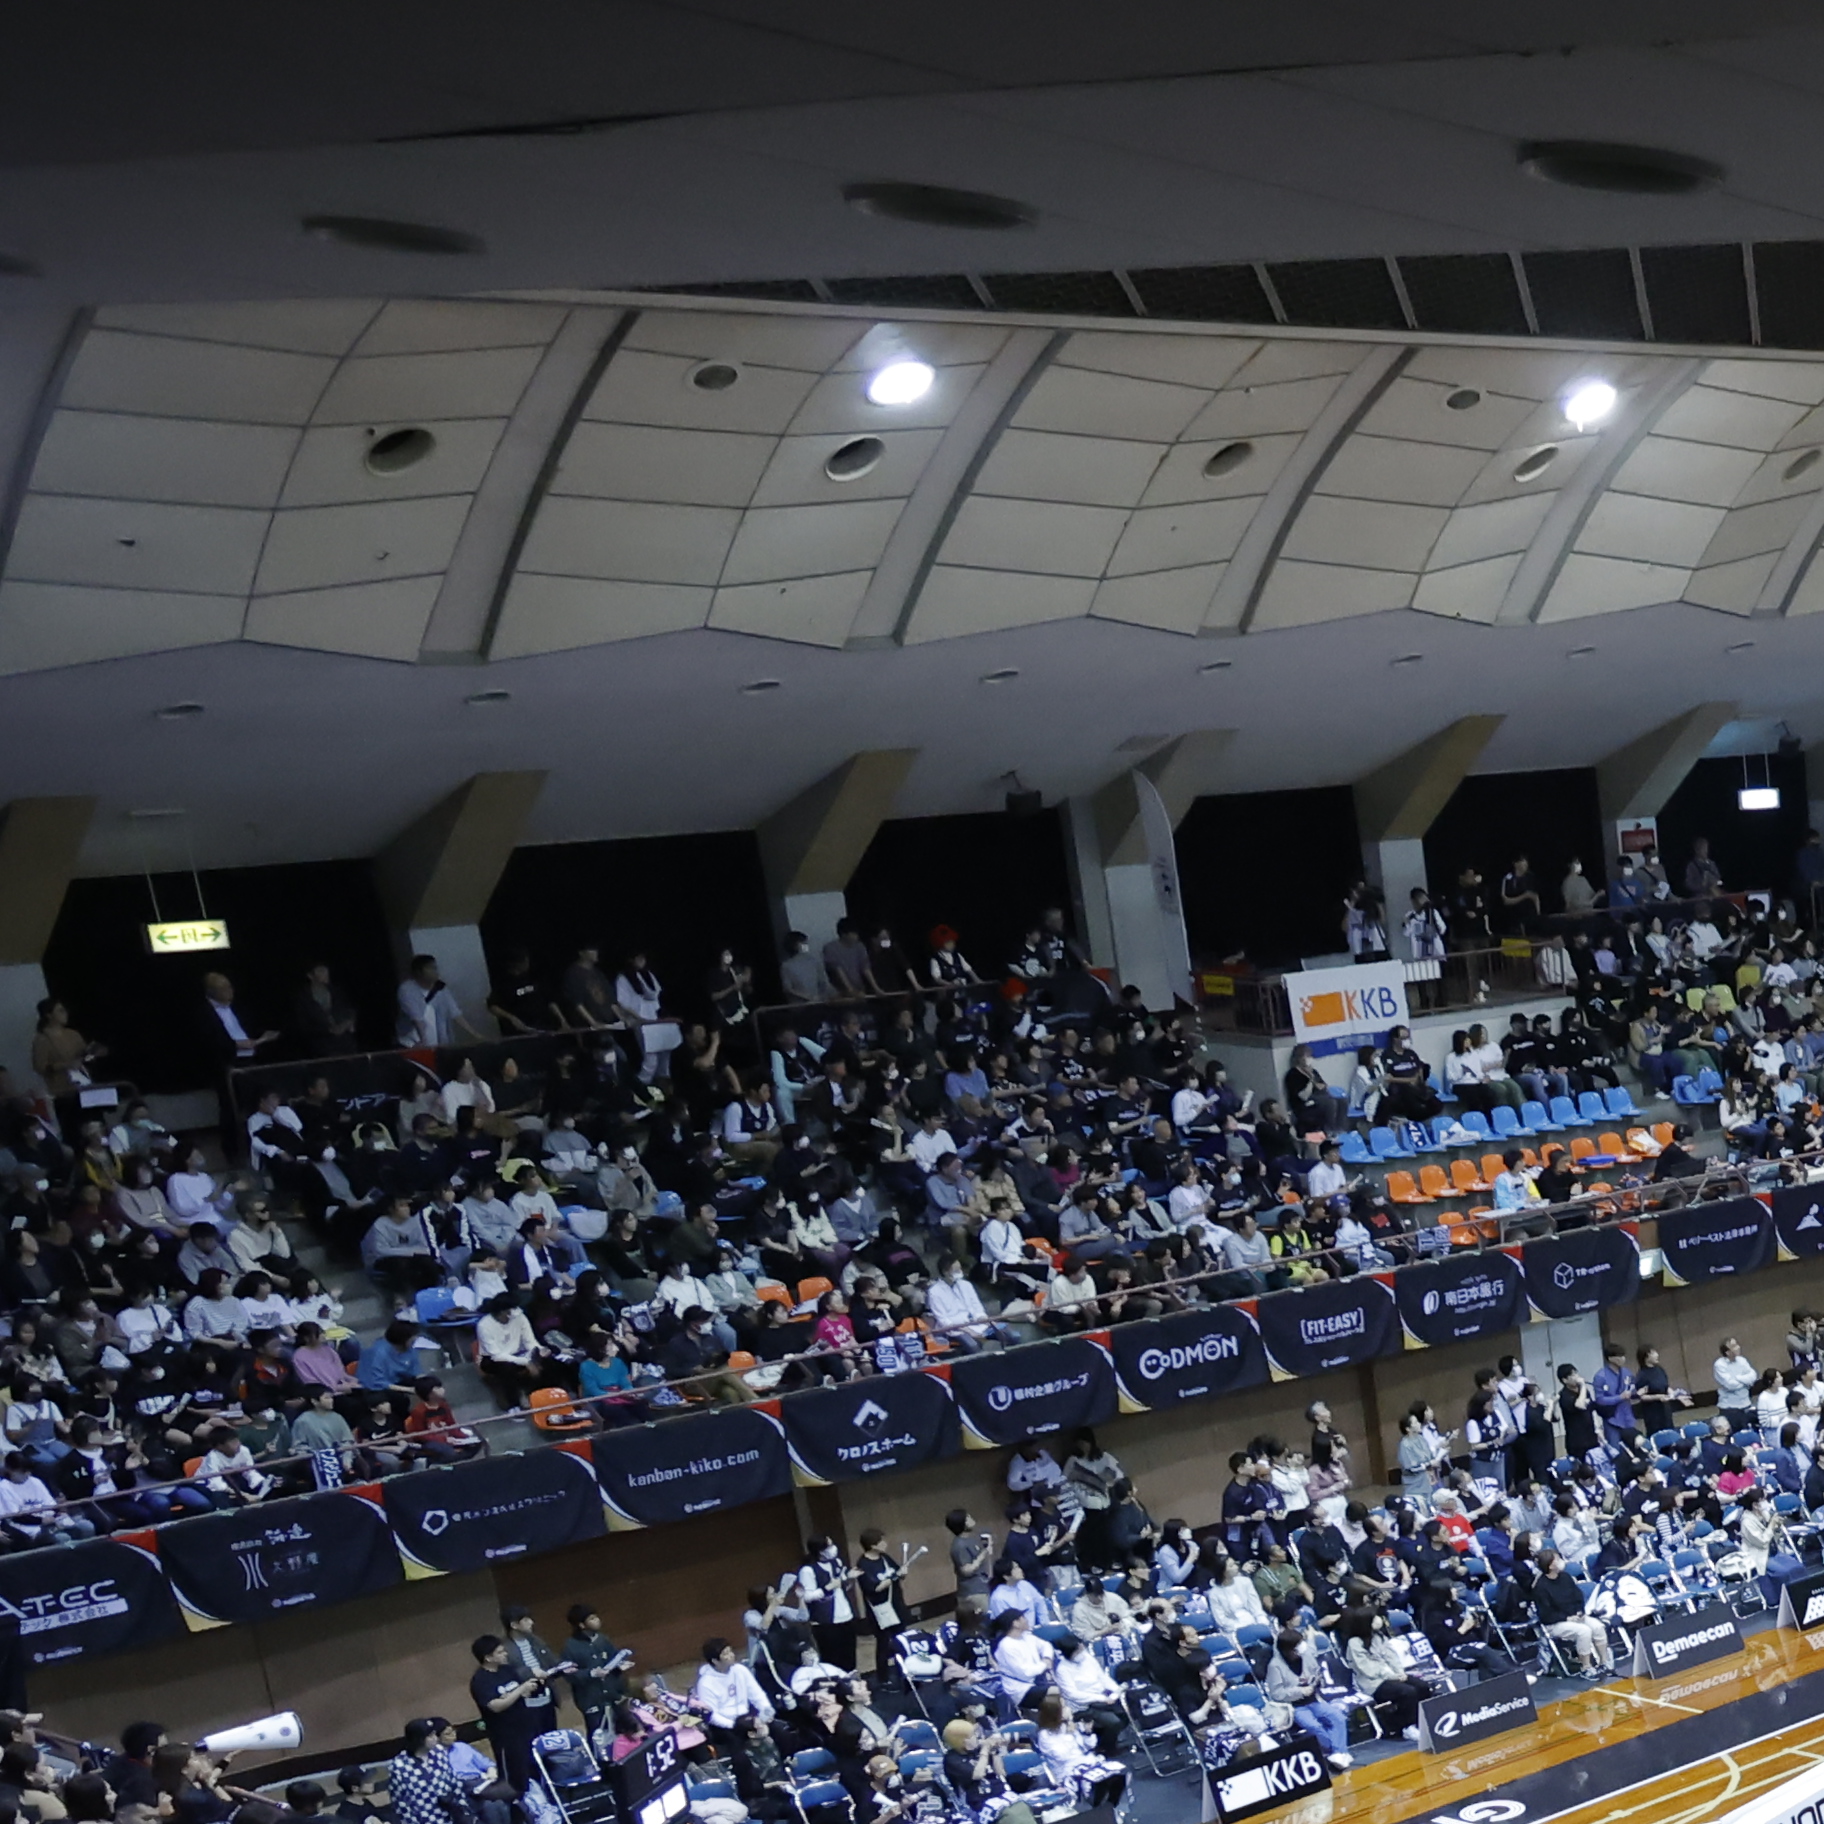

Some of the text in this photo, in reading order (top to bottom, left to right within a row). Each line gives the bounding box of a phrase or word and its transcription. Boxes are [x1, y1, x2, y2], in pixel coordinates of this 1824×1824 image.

[1344, 986, 1398, 1020] KKB
[628, 1448, 760, 1488] kanban-kiko.com
[1652, 1621, 1735, 1664] Demaecan
[1460, 1695, 1529, 1728] MediaService
[645, 1734, 676, 1778] 1:52
[1263, 1750, 1323, 1797] KKB
